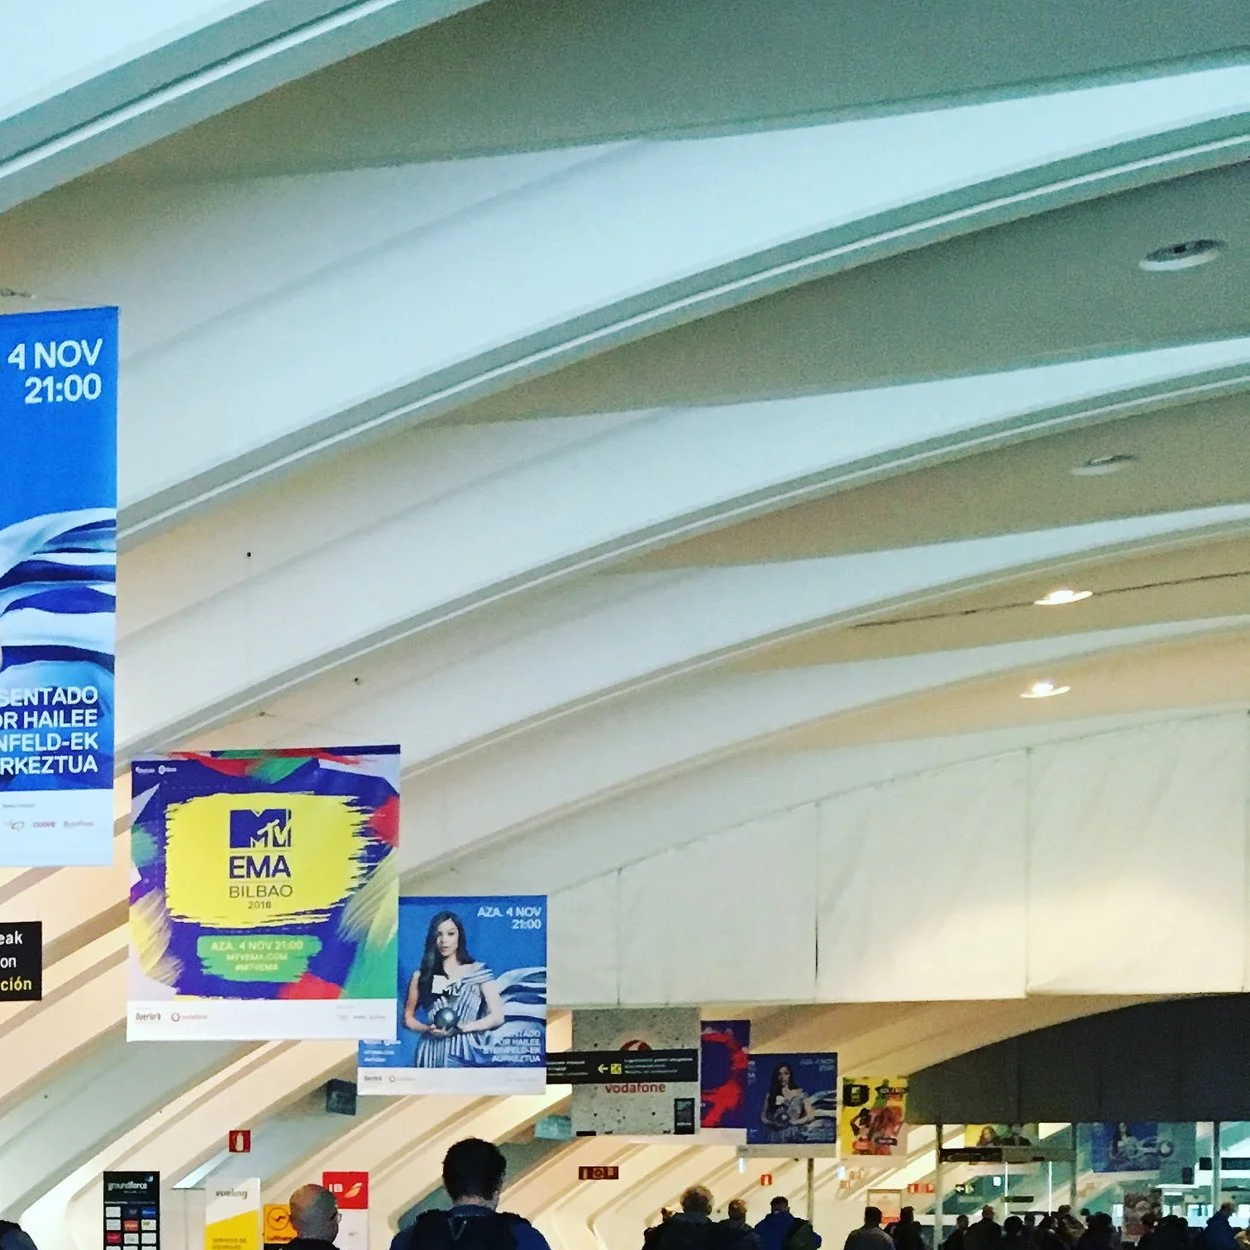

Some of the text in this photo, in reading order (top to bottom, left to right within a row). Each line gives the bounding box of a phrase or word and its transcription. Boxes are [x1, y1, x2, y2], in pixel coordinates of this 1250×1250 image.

[7, 343, 26, 371] 4
[34, 337, 103, 369] NOV
[24, 372, 102, 405] 21:00
[23, 708, 98, 729] HAILEE
[229, 808, 292, 849] MTV
[229, 854, 292, 879] EMA
[229, 884, 293, 899] BILBAO
[247, 900, 272, 910] 2018
[505, 907, 513, 917] 4
[515, 906, 542, 917] NOV
[511, 918, 542, 930] 21:00
[238, 941, 246, 951] 4
[248, 940, 272, 951] NOV
[605, 1083, 666, 1094] vodafone
[215, 1187, 249, 1200] vueling
